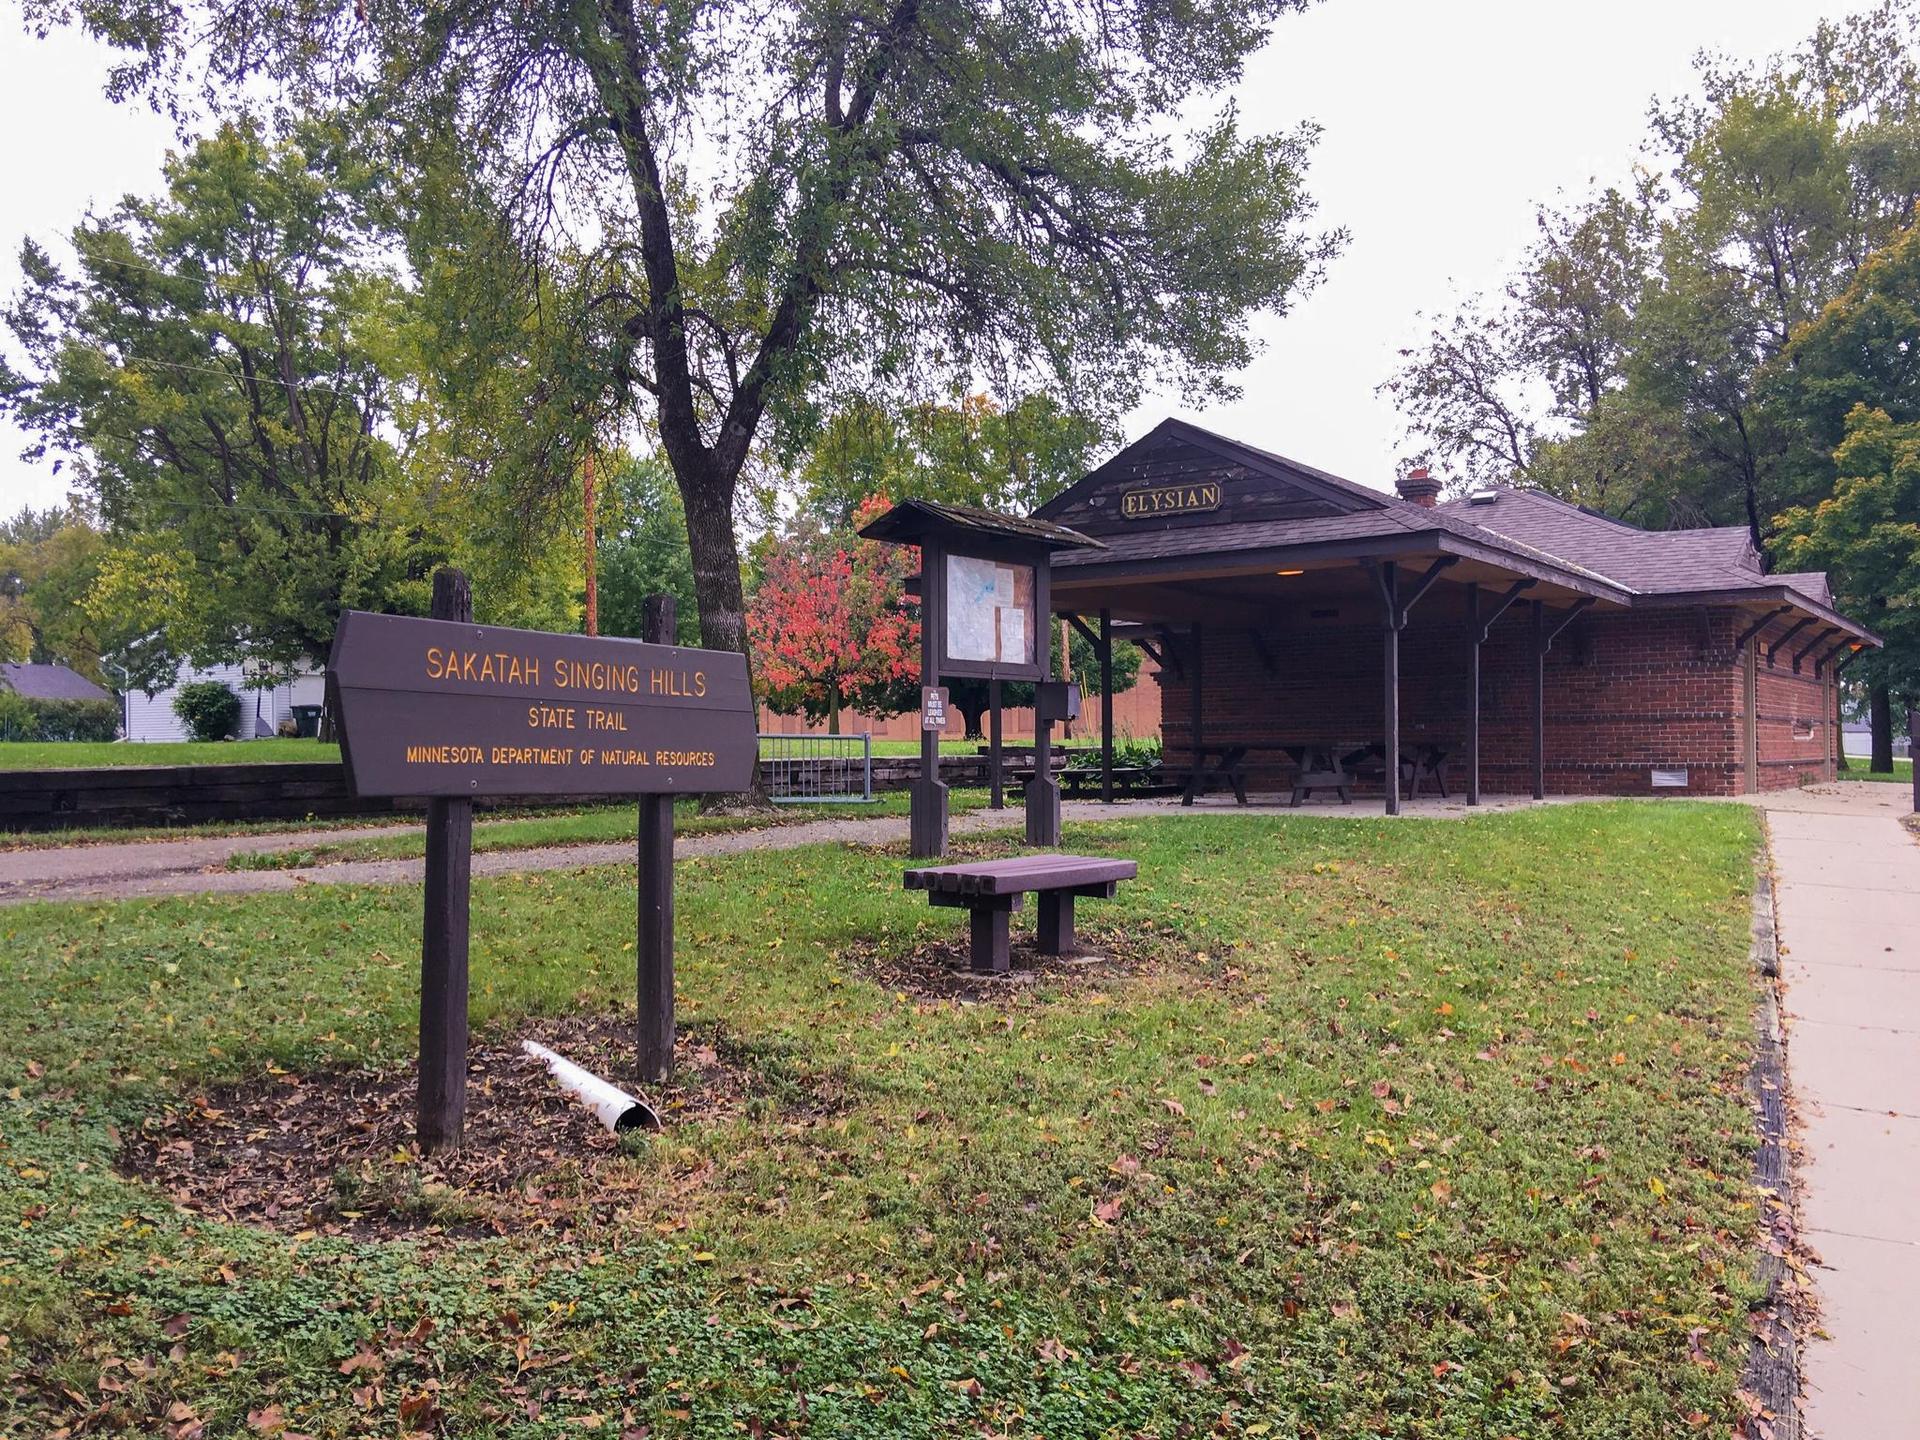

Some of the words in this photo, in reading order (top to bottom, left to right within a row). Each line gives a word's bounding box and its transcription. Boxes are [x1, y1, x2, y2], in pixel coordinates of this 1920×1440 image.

[1127, 487, 1215, 513] ELYSIAN
[427, 648, 539, 686] SAKATAH
[554, 660, 639, 693] SINGING
[651, 669, 706, 697] HILLS
[529, 707, 576, 728] STATE
[586, 710, 628, 731] TRAIL
[407, 746, 484, 763] MINNESOTA
[491, 747, 574, 765] DEPARTMENT
[580, 749, 595, 765] OF
[601, 750, 650, 766] NATURAL
[656, 751, 715, 766] RESOURCES
